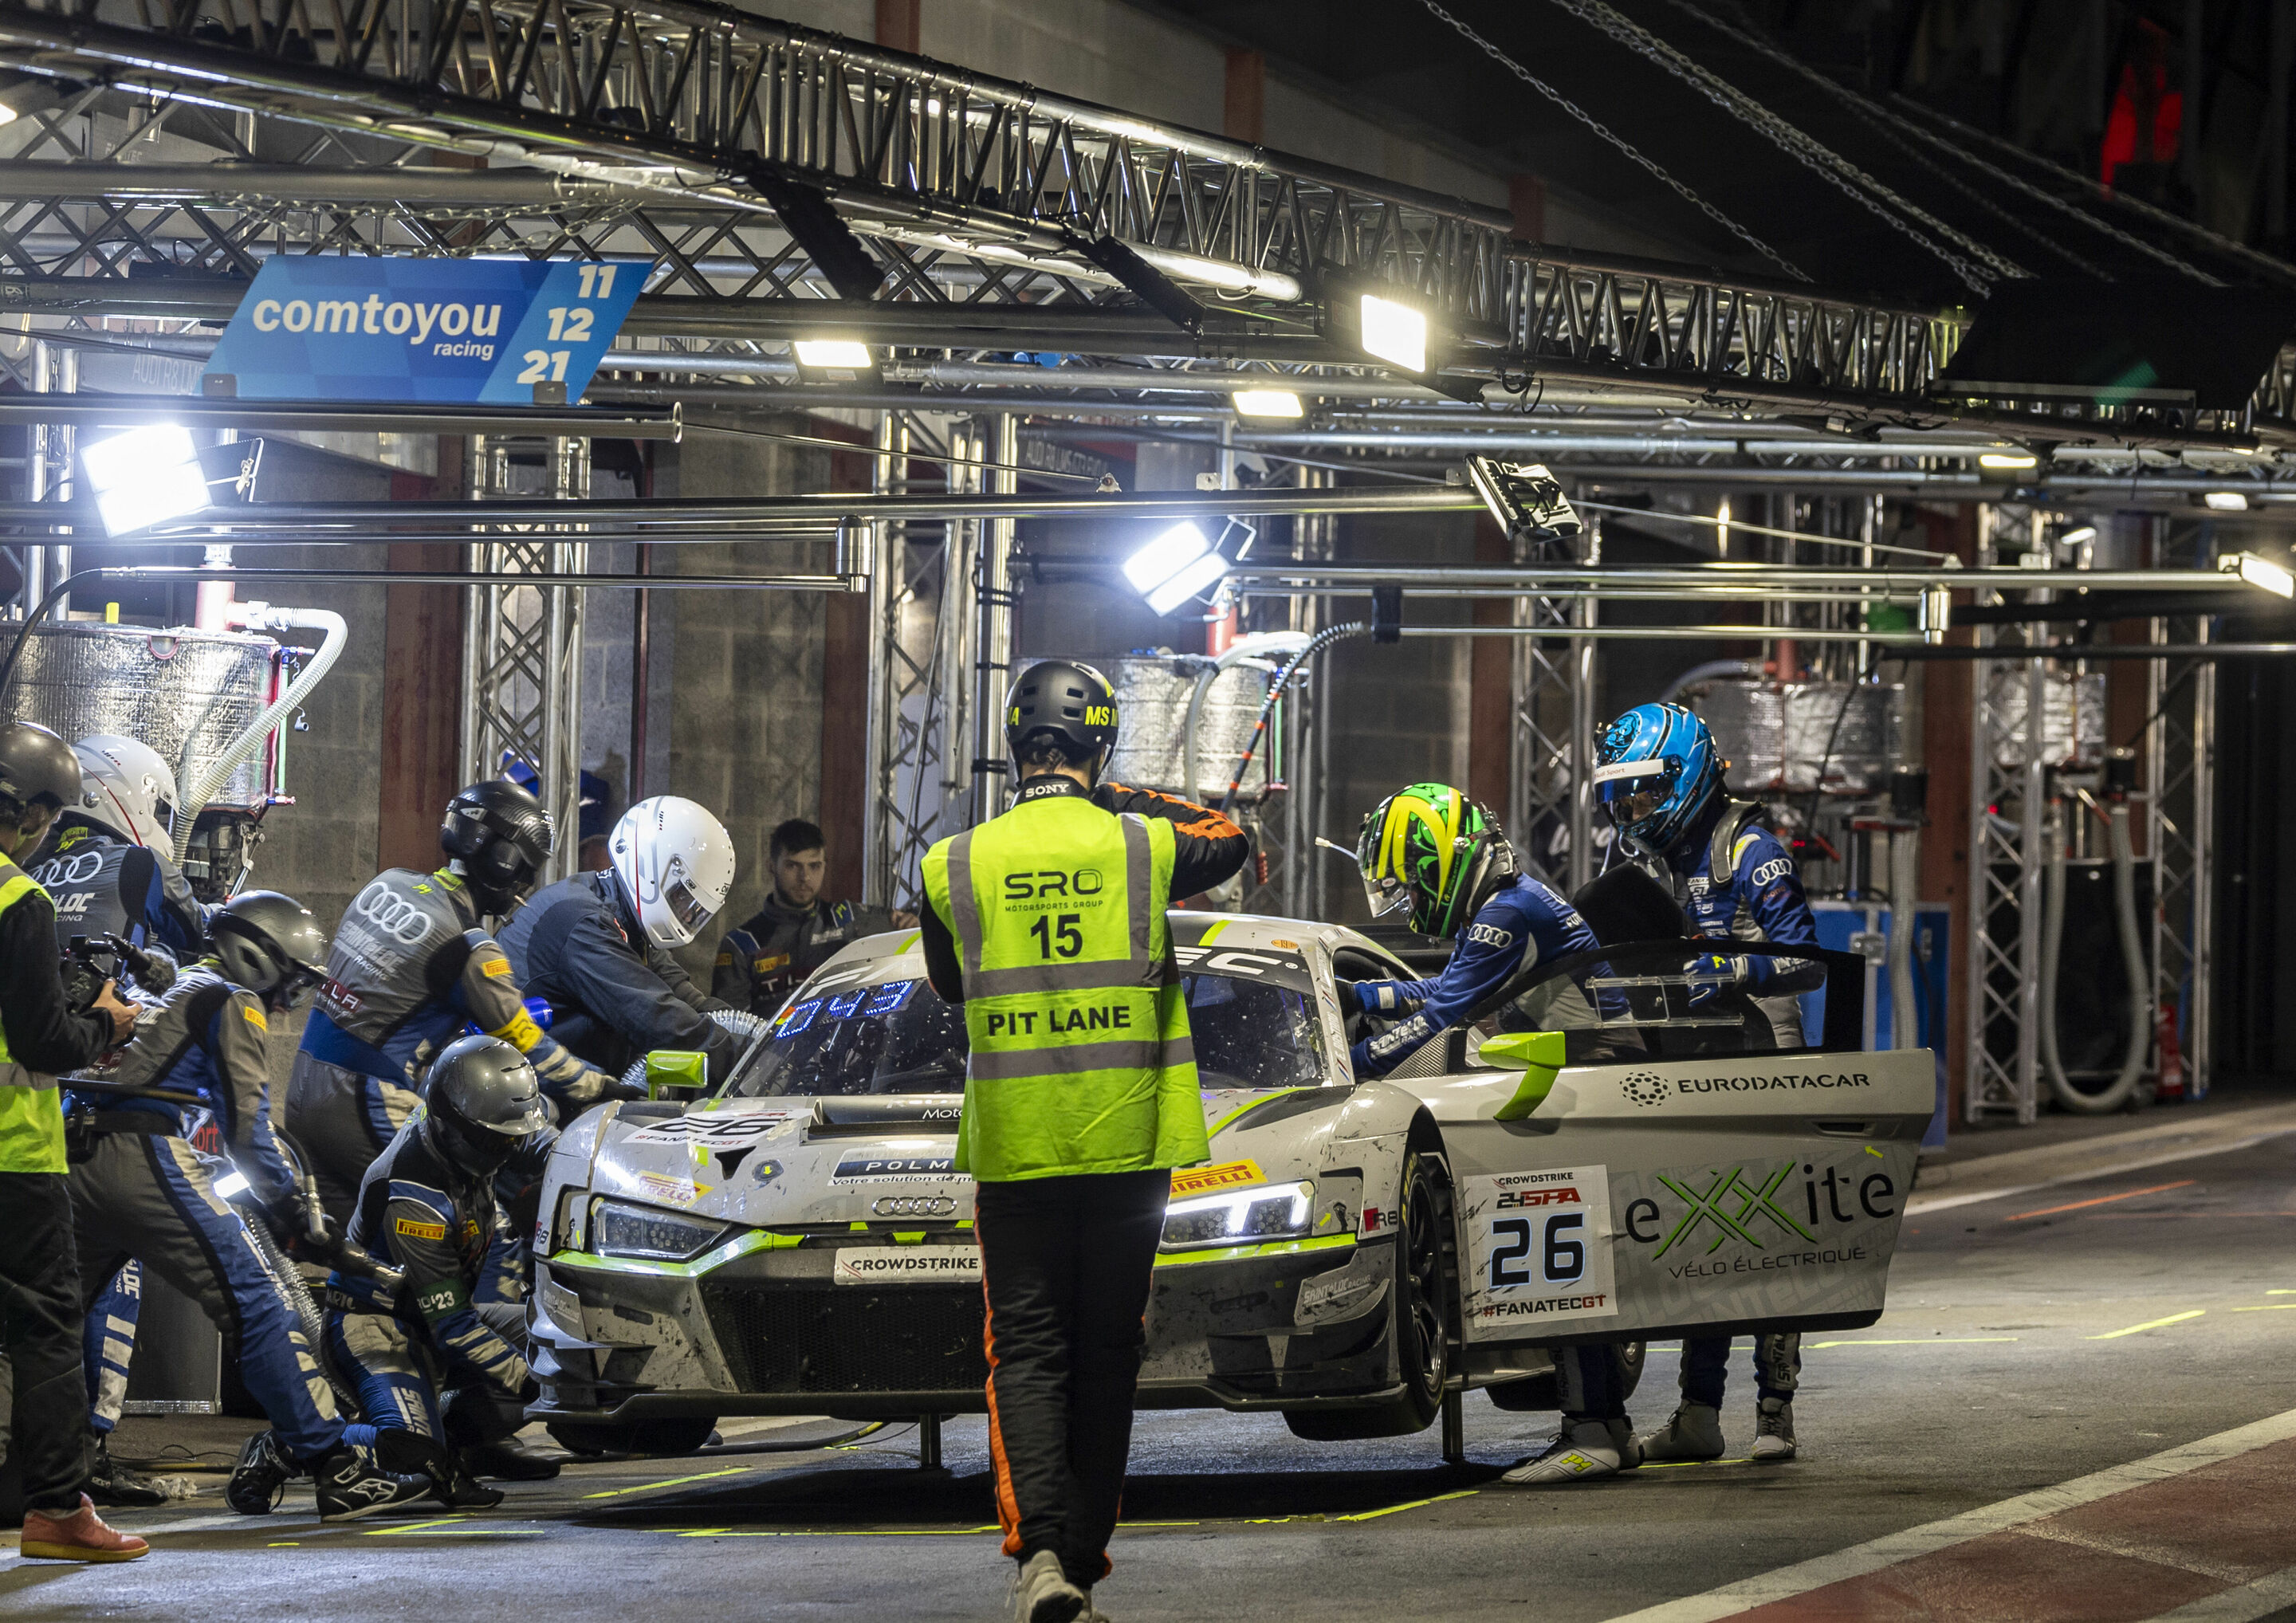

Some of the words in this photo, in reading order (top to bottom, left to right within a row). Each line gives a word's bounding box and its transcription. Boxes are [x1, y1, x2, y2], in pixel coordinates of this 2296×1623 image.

[578, 265, 618, 299] 11
[253, 293, 501, 344] comtoyou
[548, 308, 595, 342] 12
[433, 340, 494, 362] racing
[517, 351, 571, 383] 21
[1084, 705, 1110, 727] MS
[1025, 784, 1070, 799] SONY
[1004, 868, 1103, 900] SRO
[1005, 902, 1069, 913] MOTORSPORTS
[1073, 899, 1104, 909] GROUP
[1030, 914, 1083, 960] 15
[988, 1012, 1039, 1037] PIT
[1048, 1005, 1131, 1033] LANE
[1677, 1073, 1870, 1094] EURODATACAR
[873, 1175, 931, 1184] solution
[1498, 1172, 1574, 1185] CROWDSTRIKE
[1373, 1210, 1398, 1227] R8
[398, 1220, 443, 1240] PIRELLI
[1489, 1211, 1586, 1288] 26
[851, 1257, 979, 1271] CROWDSTRIKE
[1669, 1261, 1727, 1279] VÉLO
[1733, 1247, 1867, 1273] ÉLECTRIQUE
[1348, 1275, 1371, 1290] RACING
[1482, 1294, 1606, 1318] #FANATECGT
